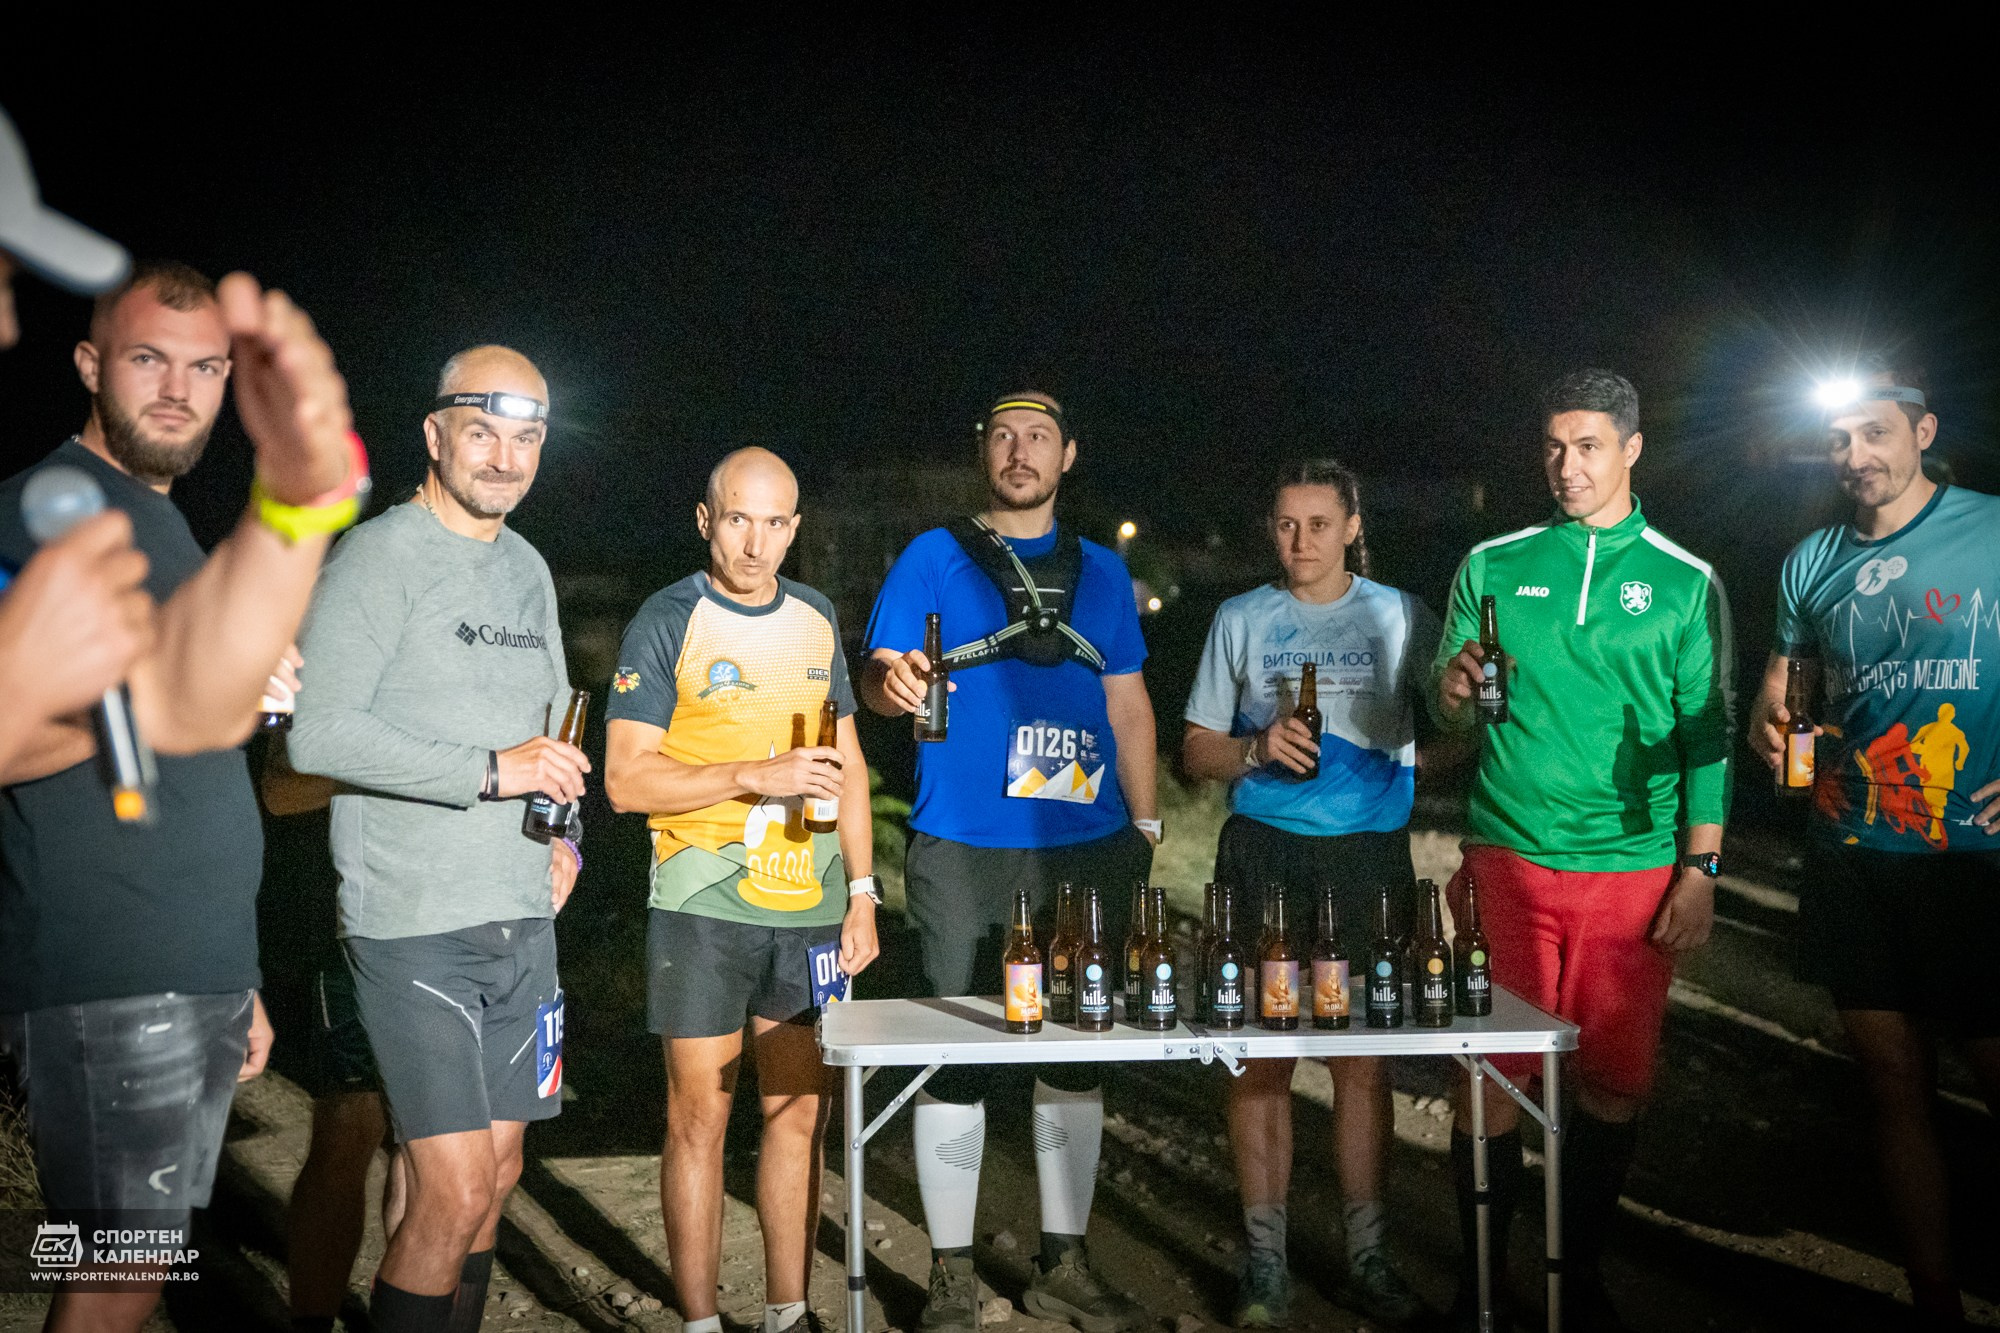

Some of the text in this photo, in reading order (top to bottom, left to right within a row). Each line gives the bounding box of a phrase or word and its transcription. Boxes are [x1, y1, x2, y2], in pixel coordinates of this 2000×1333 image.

[1515, 585, 1550, 598] JAKO
[960, 646, 999, 660] ZELAFIT
[1340, 651, 1373, 666] 100
[1480, 686, 1501, 699] hills
[1017, 726, 1077, 759] 0126
[1051, 980, 1073, 995] hills
[1467, 975, 1489, 990] hills
[1082, 990, 1107, 1005] hills
[1152, 989, 1174, 1005] hills
[1217, 989, 1241, 1004] hills
[1372, 987, 1396, 1002] hills
[1424, 984, 1448, 999] hills
